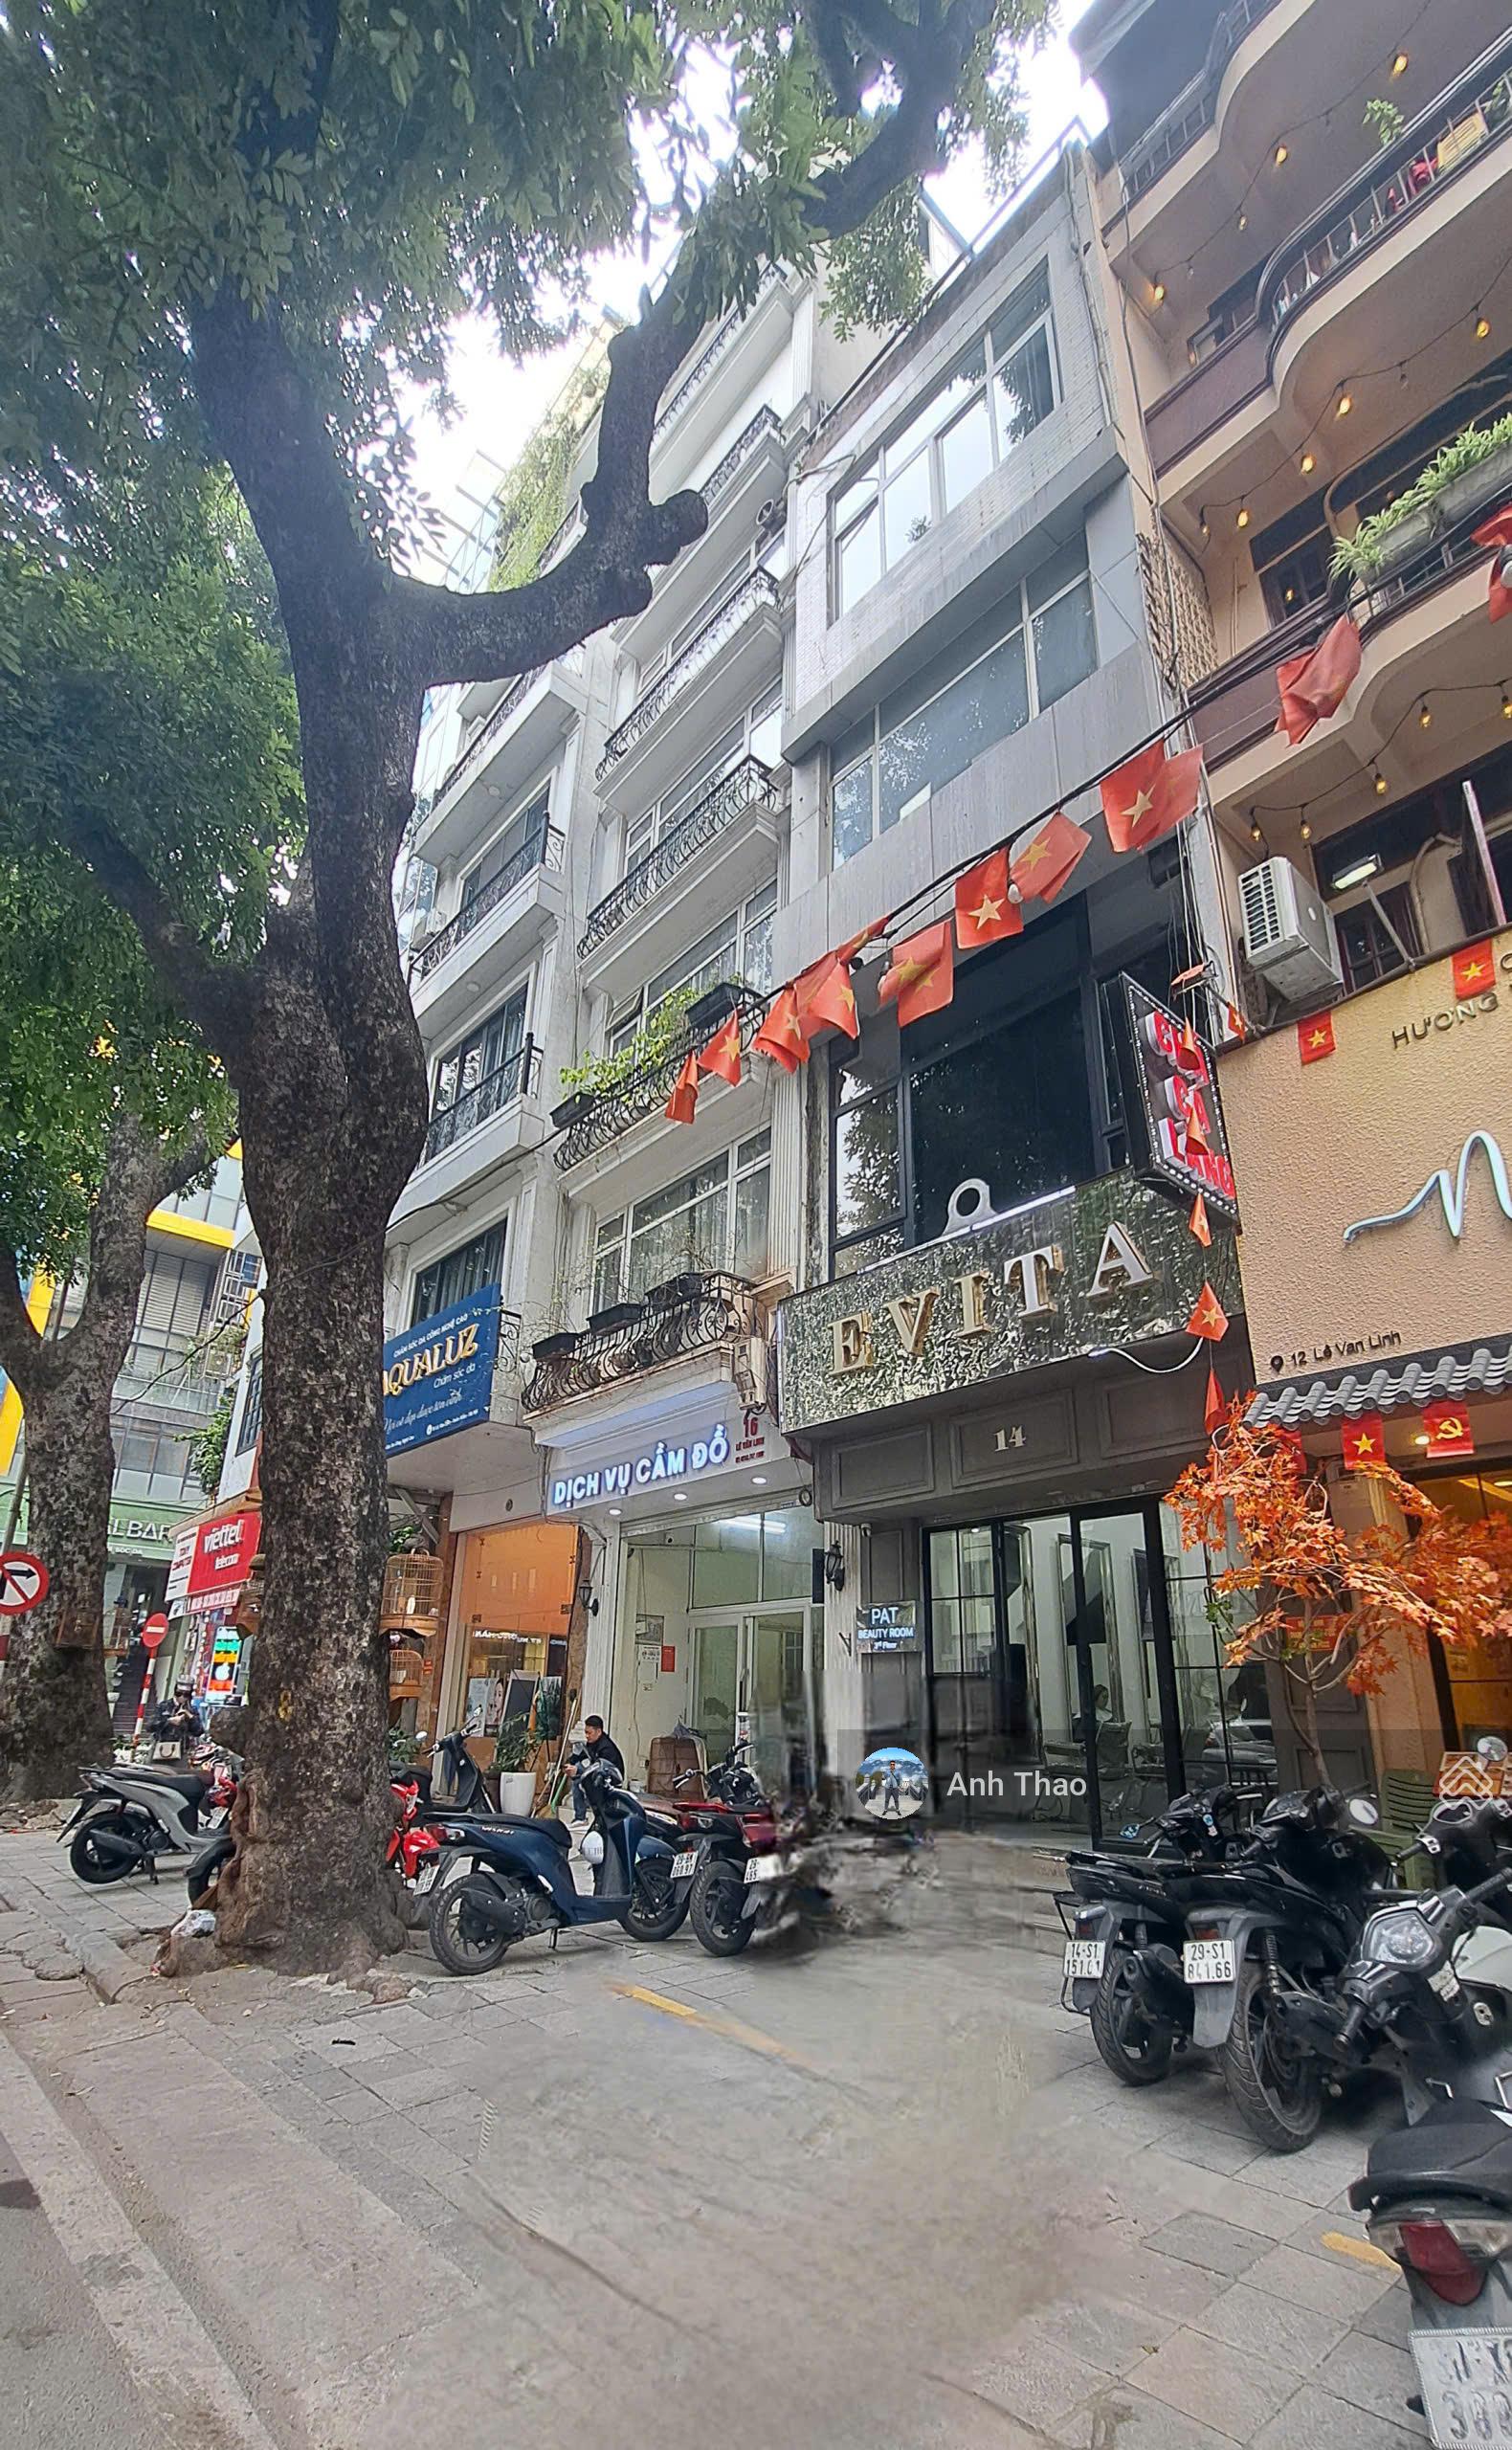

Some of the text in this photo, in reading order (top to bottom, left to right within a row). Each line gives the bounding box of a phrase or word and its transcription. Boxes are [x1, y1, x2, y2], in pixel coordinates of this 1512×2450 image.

[828, 1220, 1161, 1376] EVITA
[1292, 1350, 1307, 1368] 12
[744, 1416, 758, 1437] 16
[994, 1425, 1027, 1452] 14
[554, 1423, 729, 1508] DỊCH VỤ CẦM ĐỒ
[871, 1606, 899, 1625] PAT
[857, 1627, 914, 1639] BEAUTY ROOM
[1190, 1942, 1226, 1962] 29-S1
